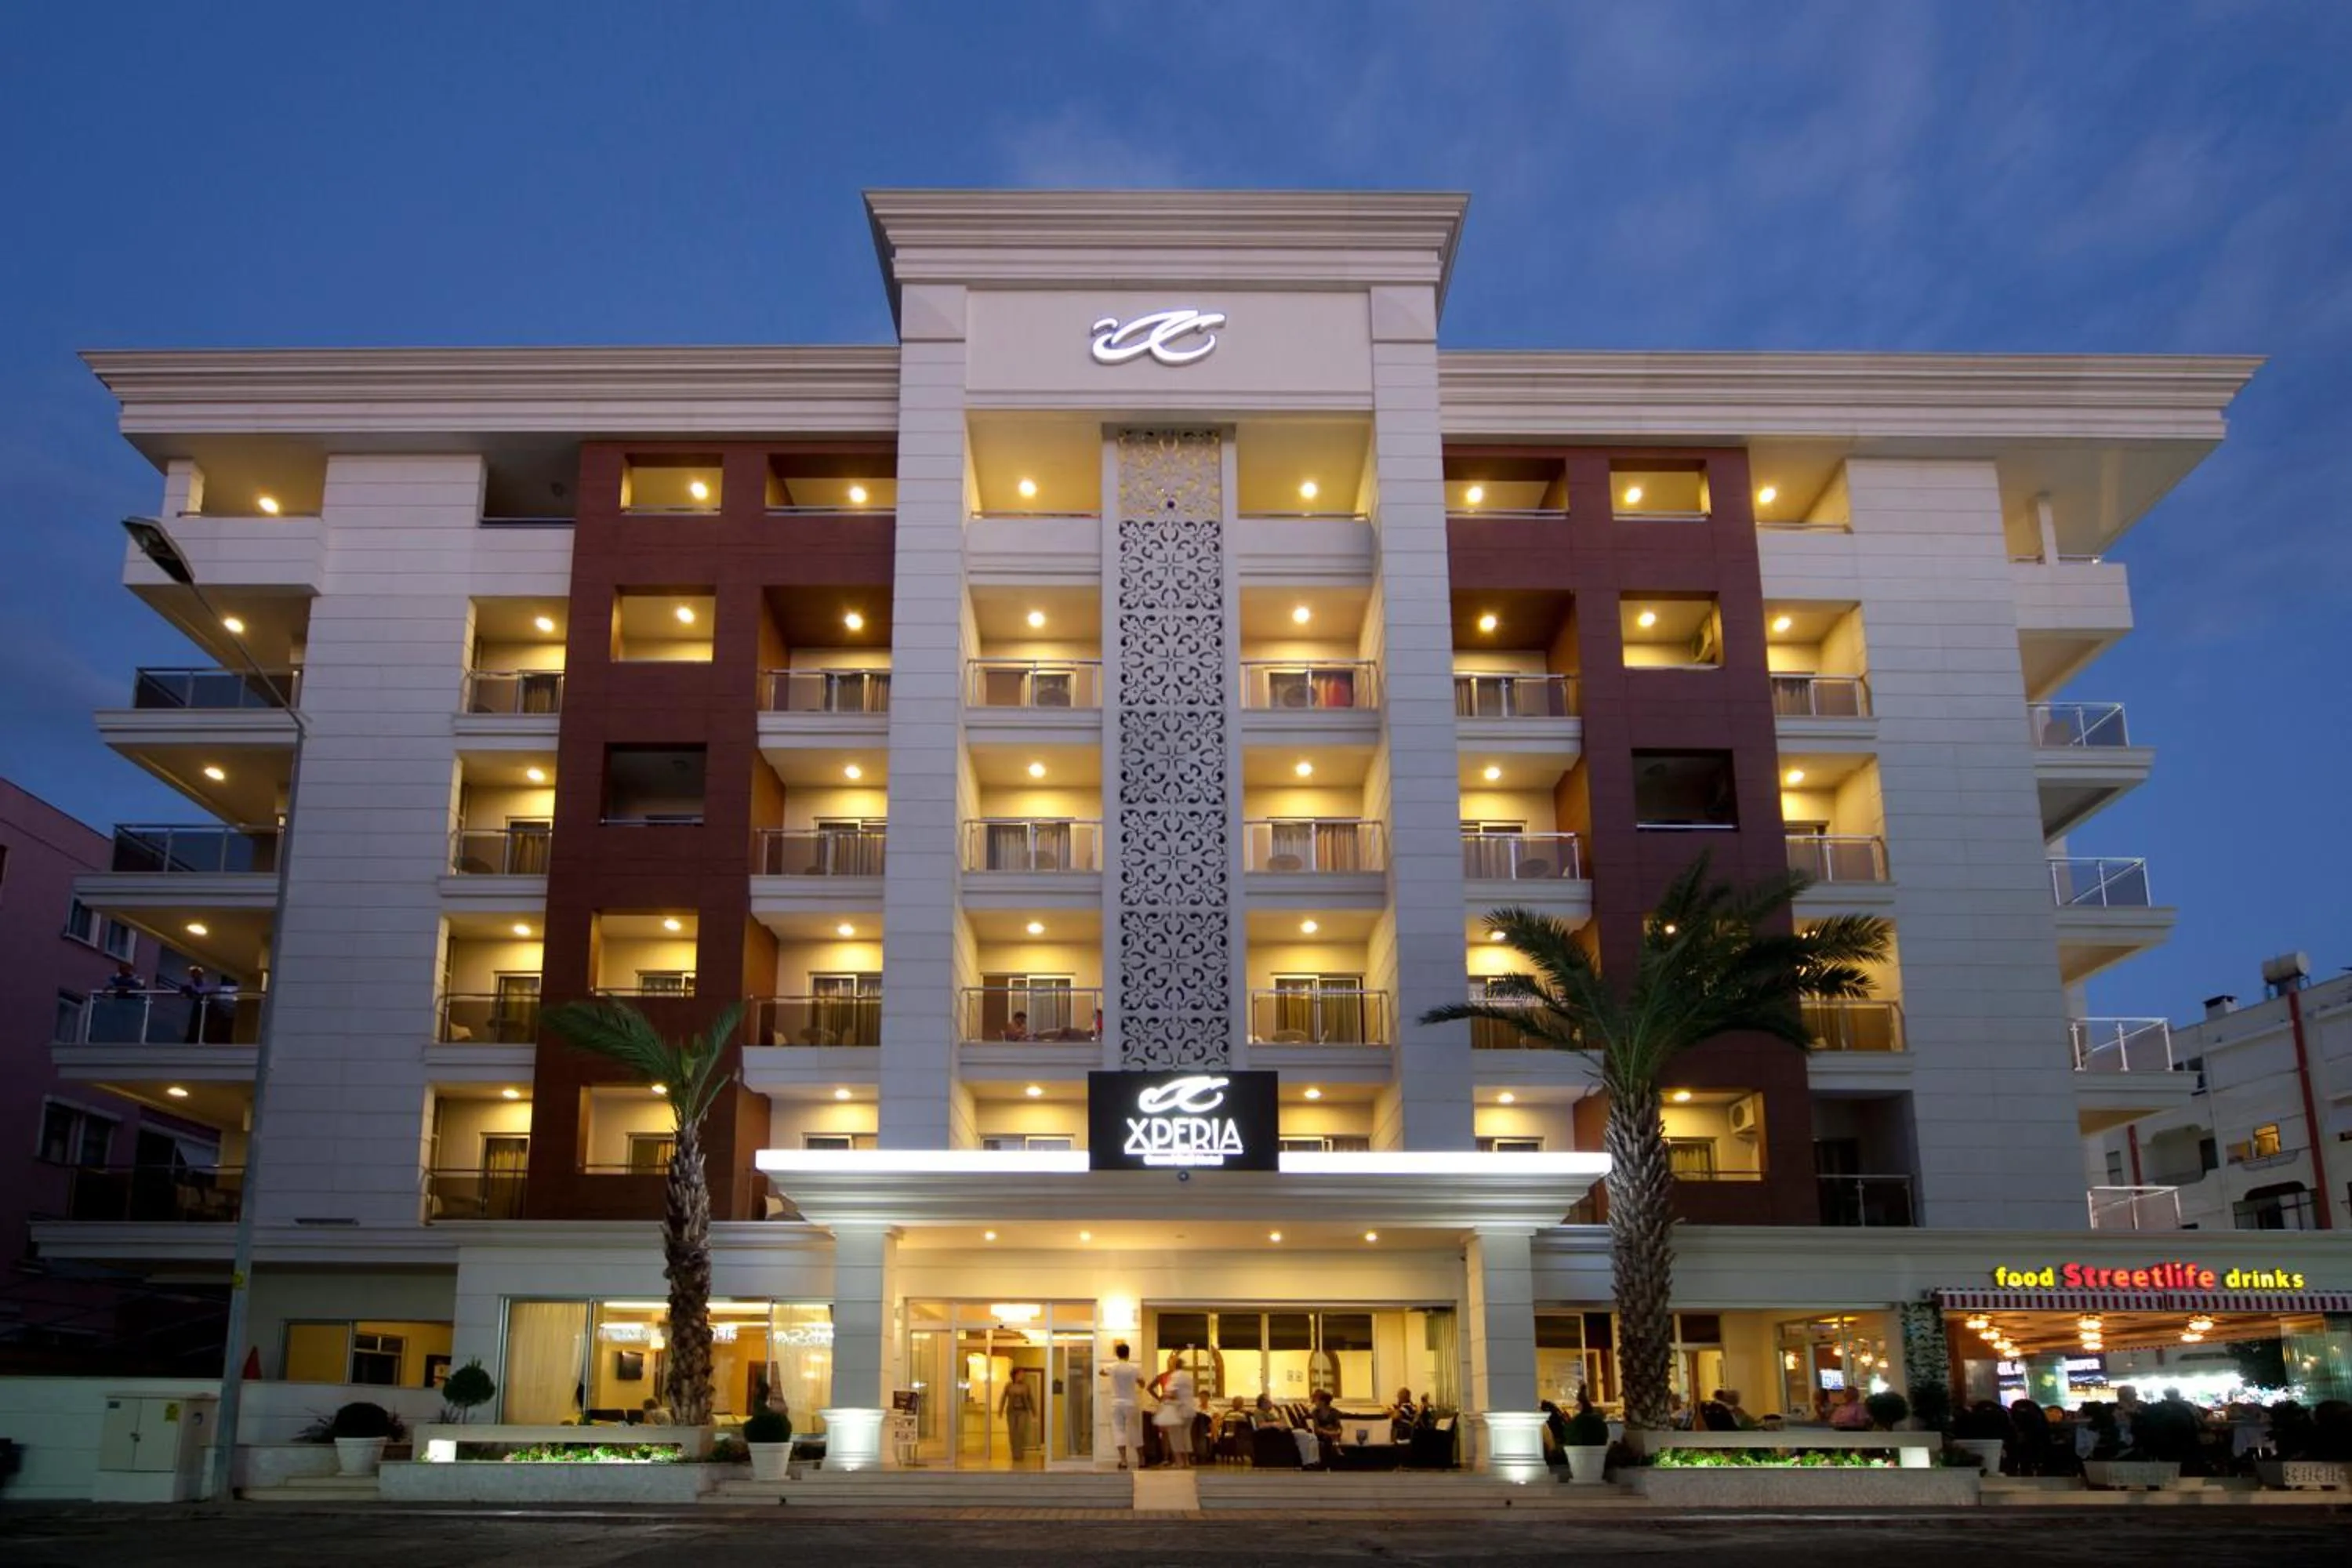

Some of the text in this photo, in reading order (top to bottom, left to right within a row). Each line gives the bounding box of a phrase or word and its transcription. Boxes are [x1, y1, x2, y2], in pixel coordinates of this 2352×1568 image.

[1123, 1117, 1244, 1155] XPERIA
[1995, 1261, 2305, 1289] food Streetlife drinks
